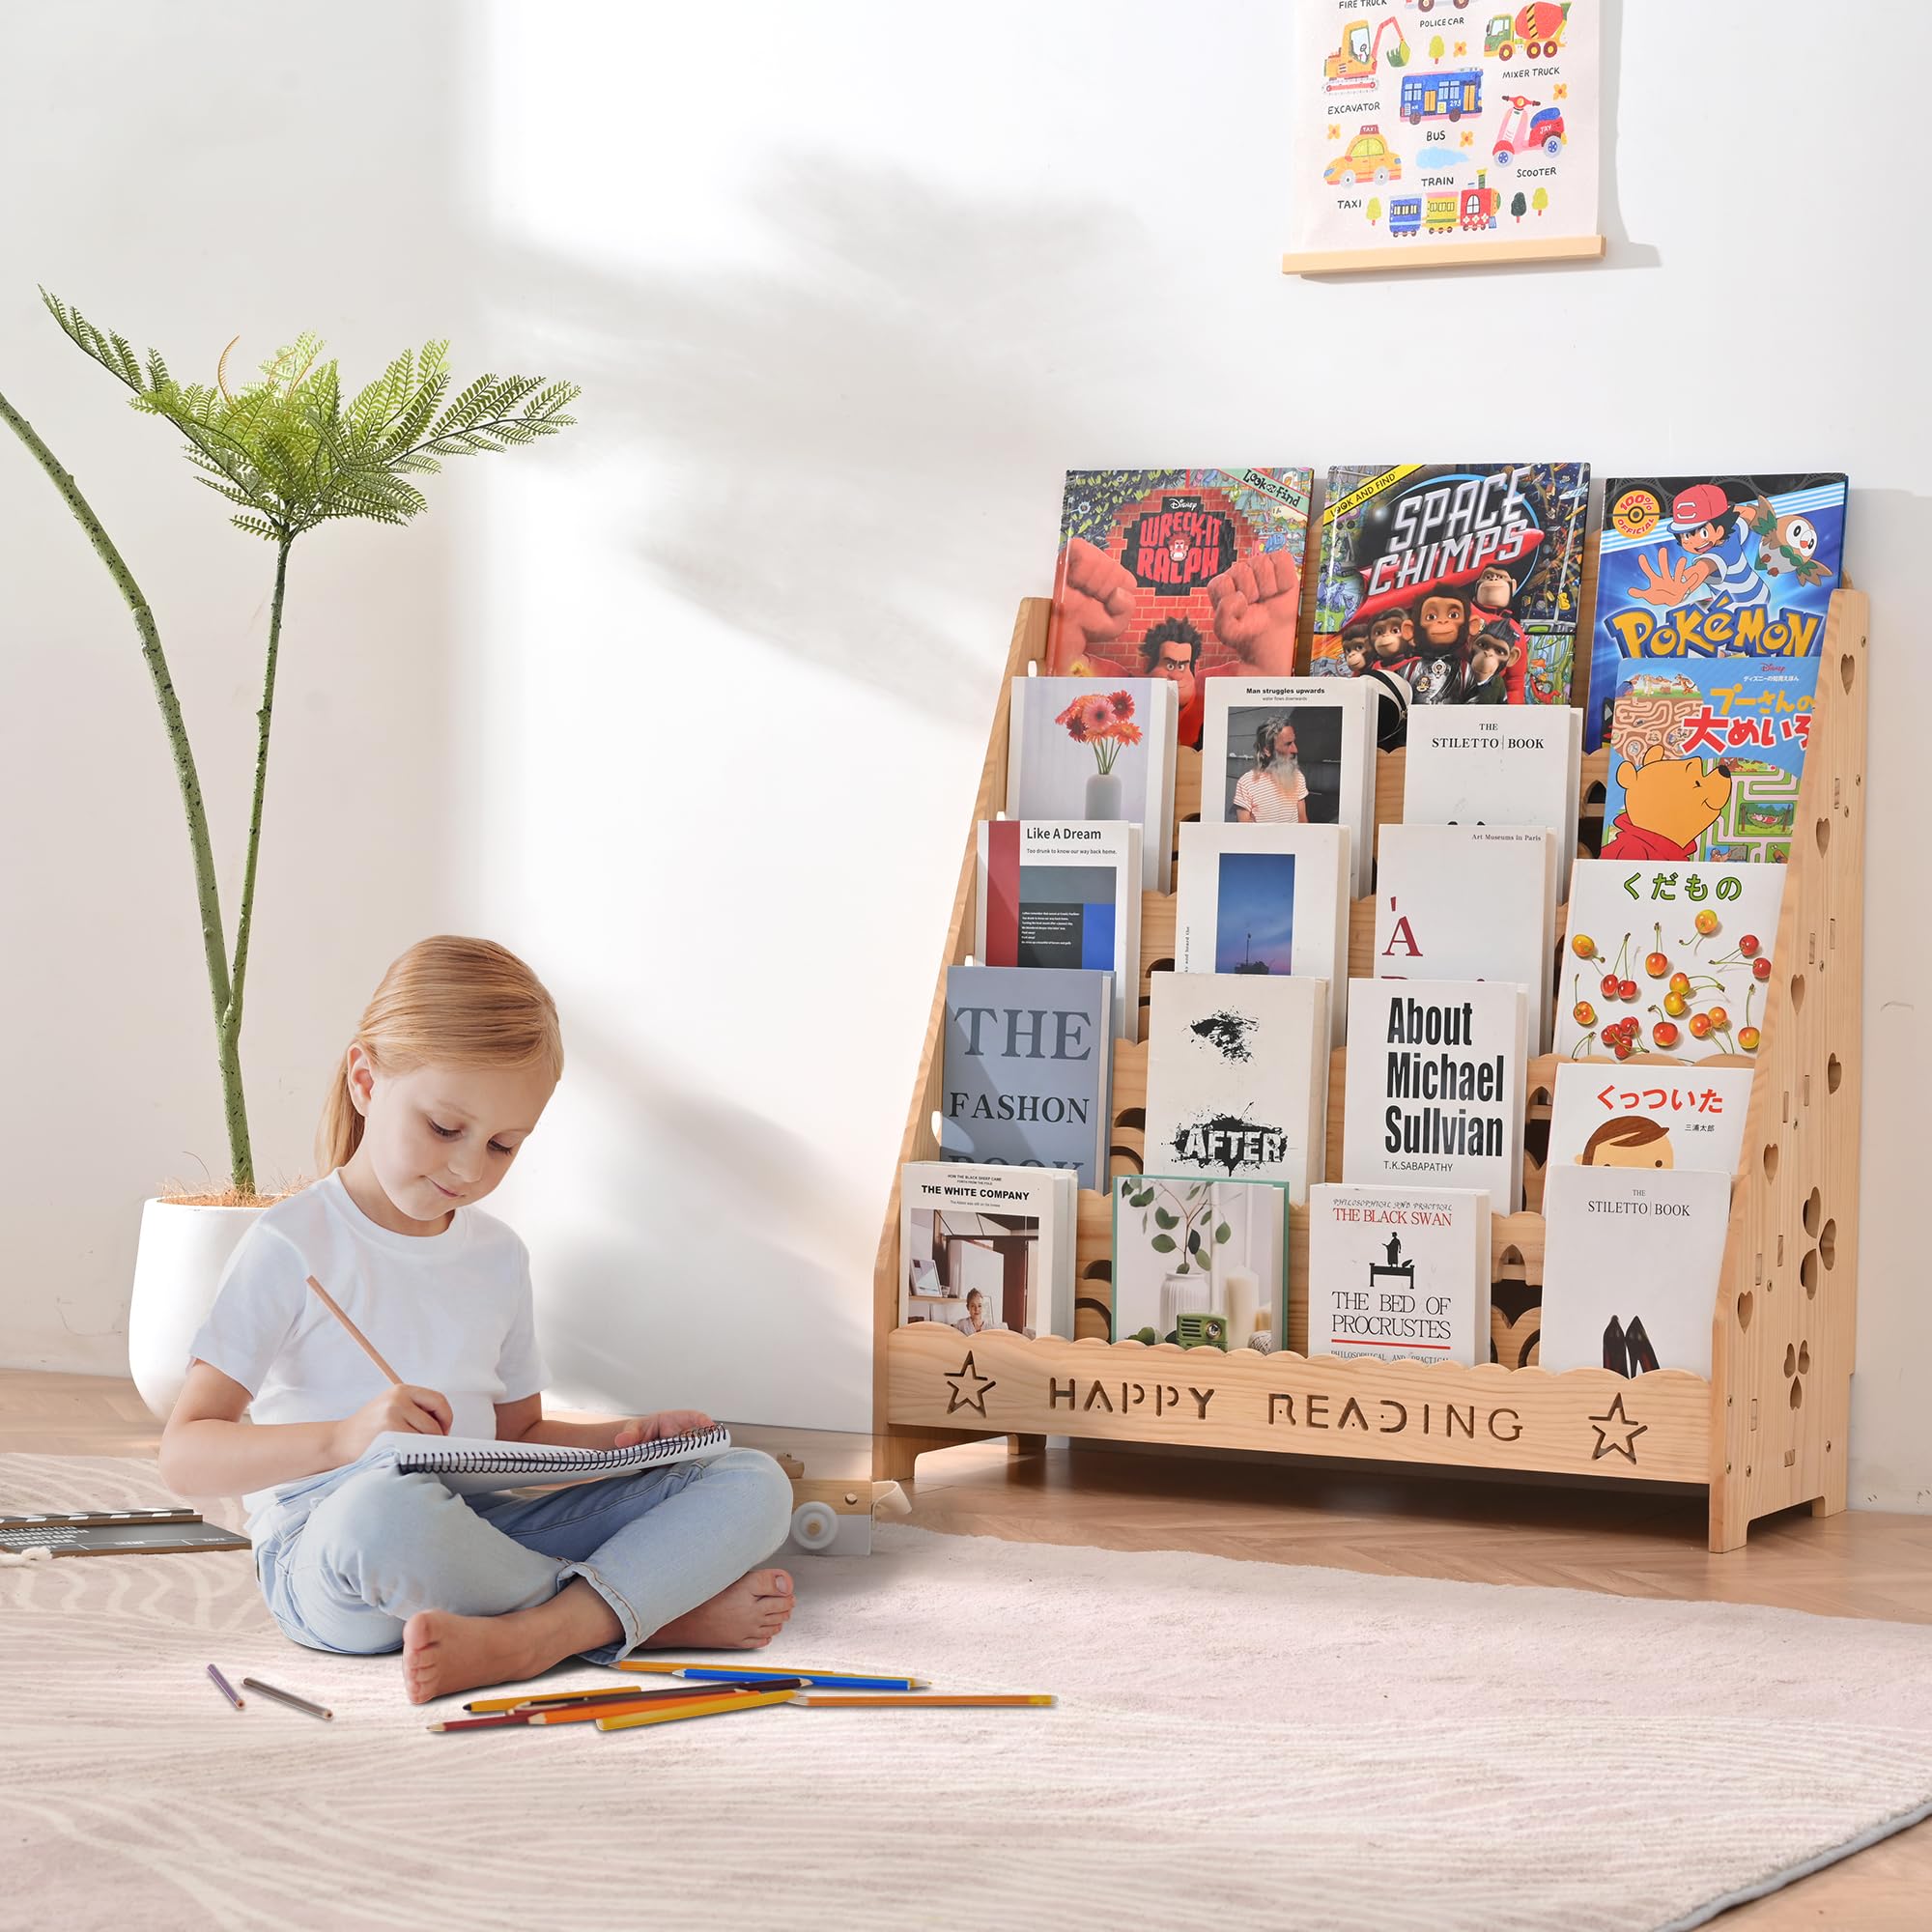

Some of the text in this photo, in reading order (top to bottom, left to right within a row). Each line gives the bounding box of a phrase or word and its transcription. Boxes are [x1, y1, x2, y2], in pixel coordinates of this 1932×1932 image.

[1339, 0, 1357, 9] FIRE
[1419, 17, 1464, 28] POLICE CAR
[1502, 67, 1560, 78] MIXER TRUCK
[1327, 101, 1380, 115] EXCAVATOR
[1426, 130, 1446, 141] BUS
[1540, 125, 1552, 134] JAY
[1517, 167, 1557, 178] SCOOTER
[1421, 177, 1455, 188] TRAIN
[1337, 199, 1362, 209] TAXI
[1276, 486, 1301, 507] Find
[1355, 486, 1375, 501] AND
[1375, 473, 1396, 490] FIND
[1386, 465, 1533, 554] SPACE
[1620, 495, 1655, 510] 100%
[1618, 519, 1655, 534] OFFICIAL
[1136, 547, 1220, 583] RALPH
[1367, 518, 1529, 597] CHIMPS
[1710, 683, 1816, 715] プーさんの
[1479, 723, 1498, 731] THE
[1432, 737, 1544, 750] STILETTO BOOK
[1027, 827, 1101, 839] Like A Dream
[1623, 872, 1743, 901] くだもの
[1387, 997, 1472, 1045] About
[953, 1008, 1092, 1061] THE
[1386, 1052, 1504, 1102] Michael
[949, 1092, 1090, 1124] FASHON
[1597, 1085, 1723, 1114] くっついた
[1384, 1105, 1503, 1157] Sullvian
[1183, 1127, 1283, 1163] AFTER
[921, 1184, 1030, 1201] THE WHITE COMPANY
[1333, 1208, 1452, 1226] THE BLACK SWAN
[1588, 1200, 1690, 1216] STILETTO BOOK
[1332, 1291, 1451, 1315] THE BED OF
[1331, 1314, 1451, 1340] PROCRUSTES
[1049, 1377, 1523, 1442] HAPPY READING
